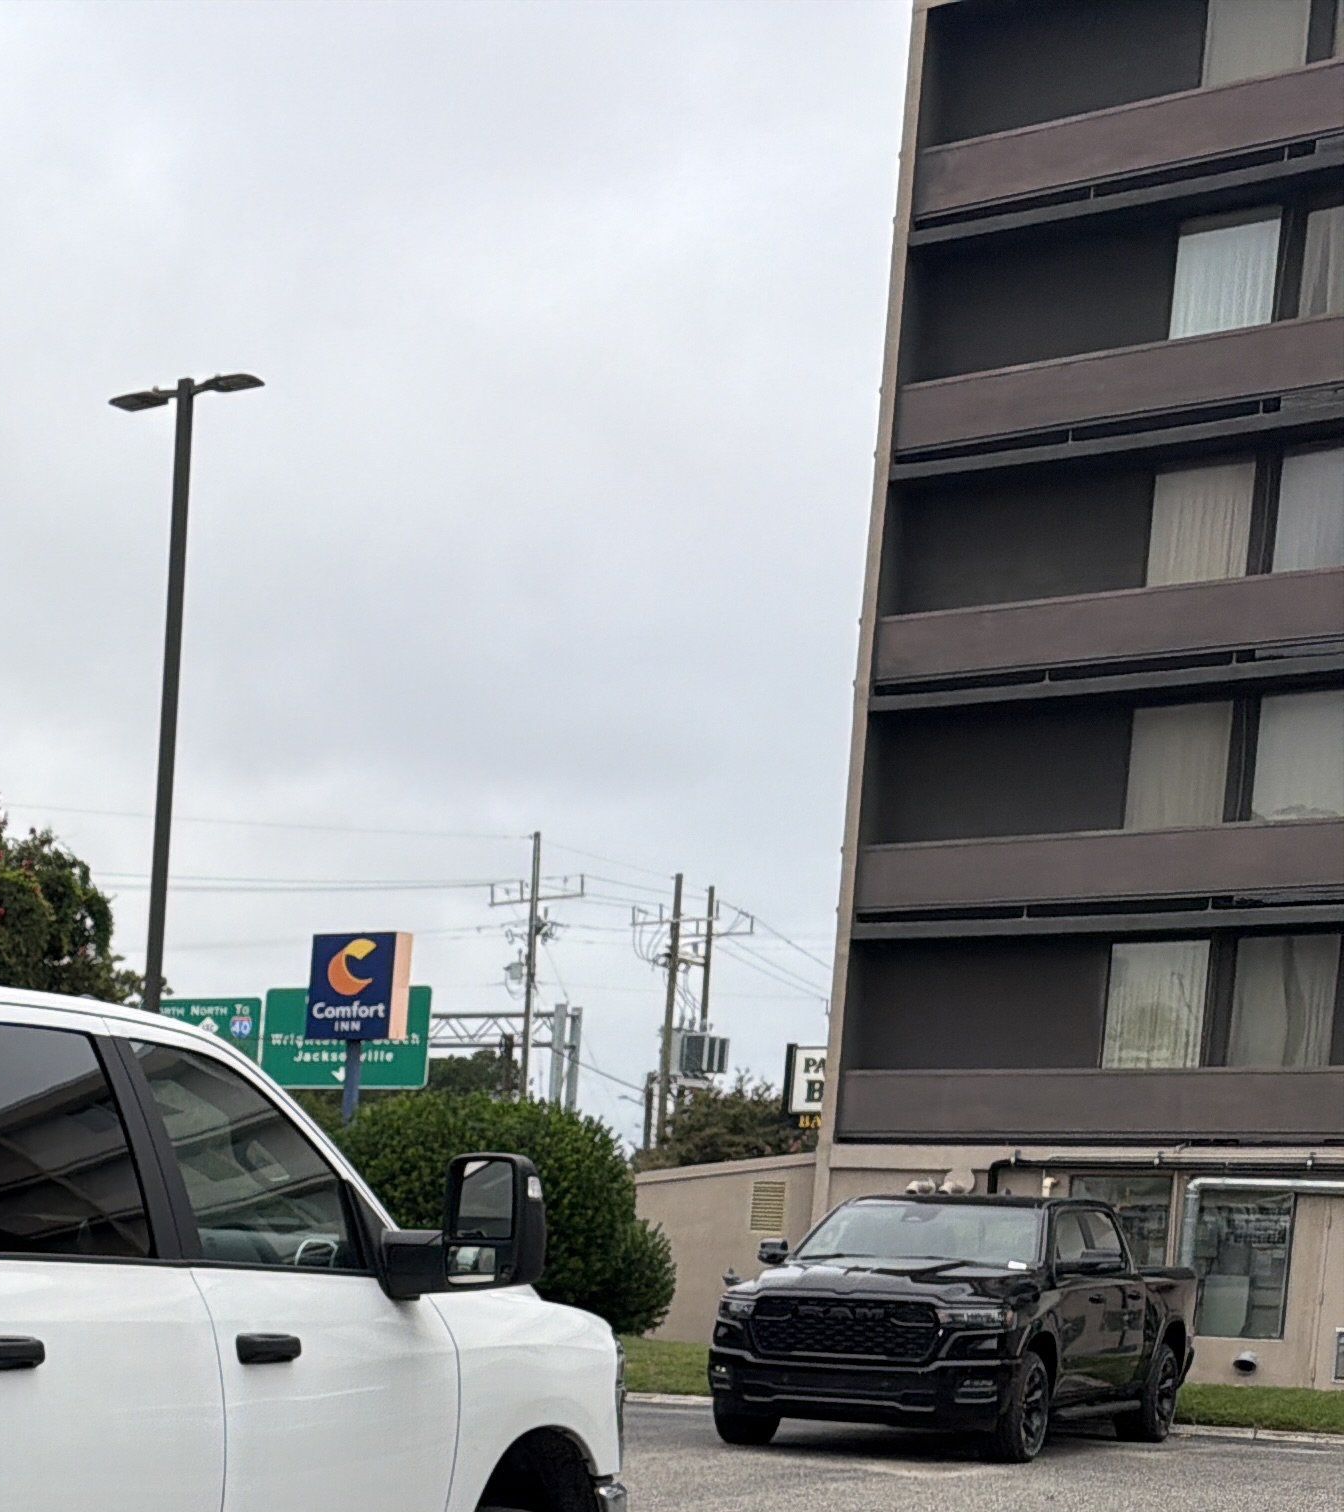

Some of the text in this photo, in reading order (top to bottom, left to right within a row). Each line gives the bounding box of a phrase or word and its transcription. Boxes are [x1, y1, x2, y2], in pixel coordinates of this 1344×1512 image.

[312, 1001, 386, 1019] Comfort
[232, 1020, 251, 1034] 40
[333, 1020, 362, 1033] INN
[293, 1050, 395, 1063] Jacksoville
